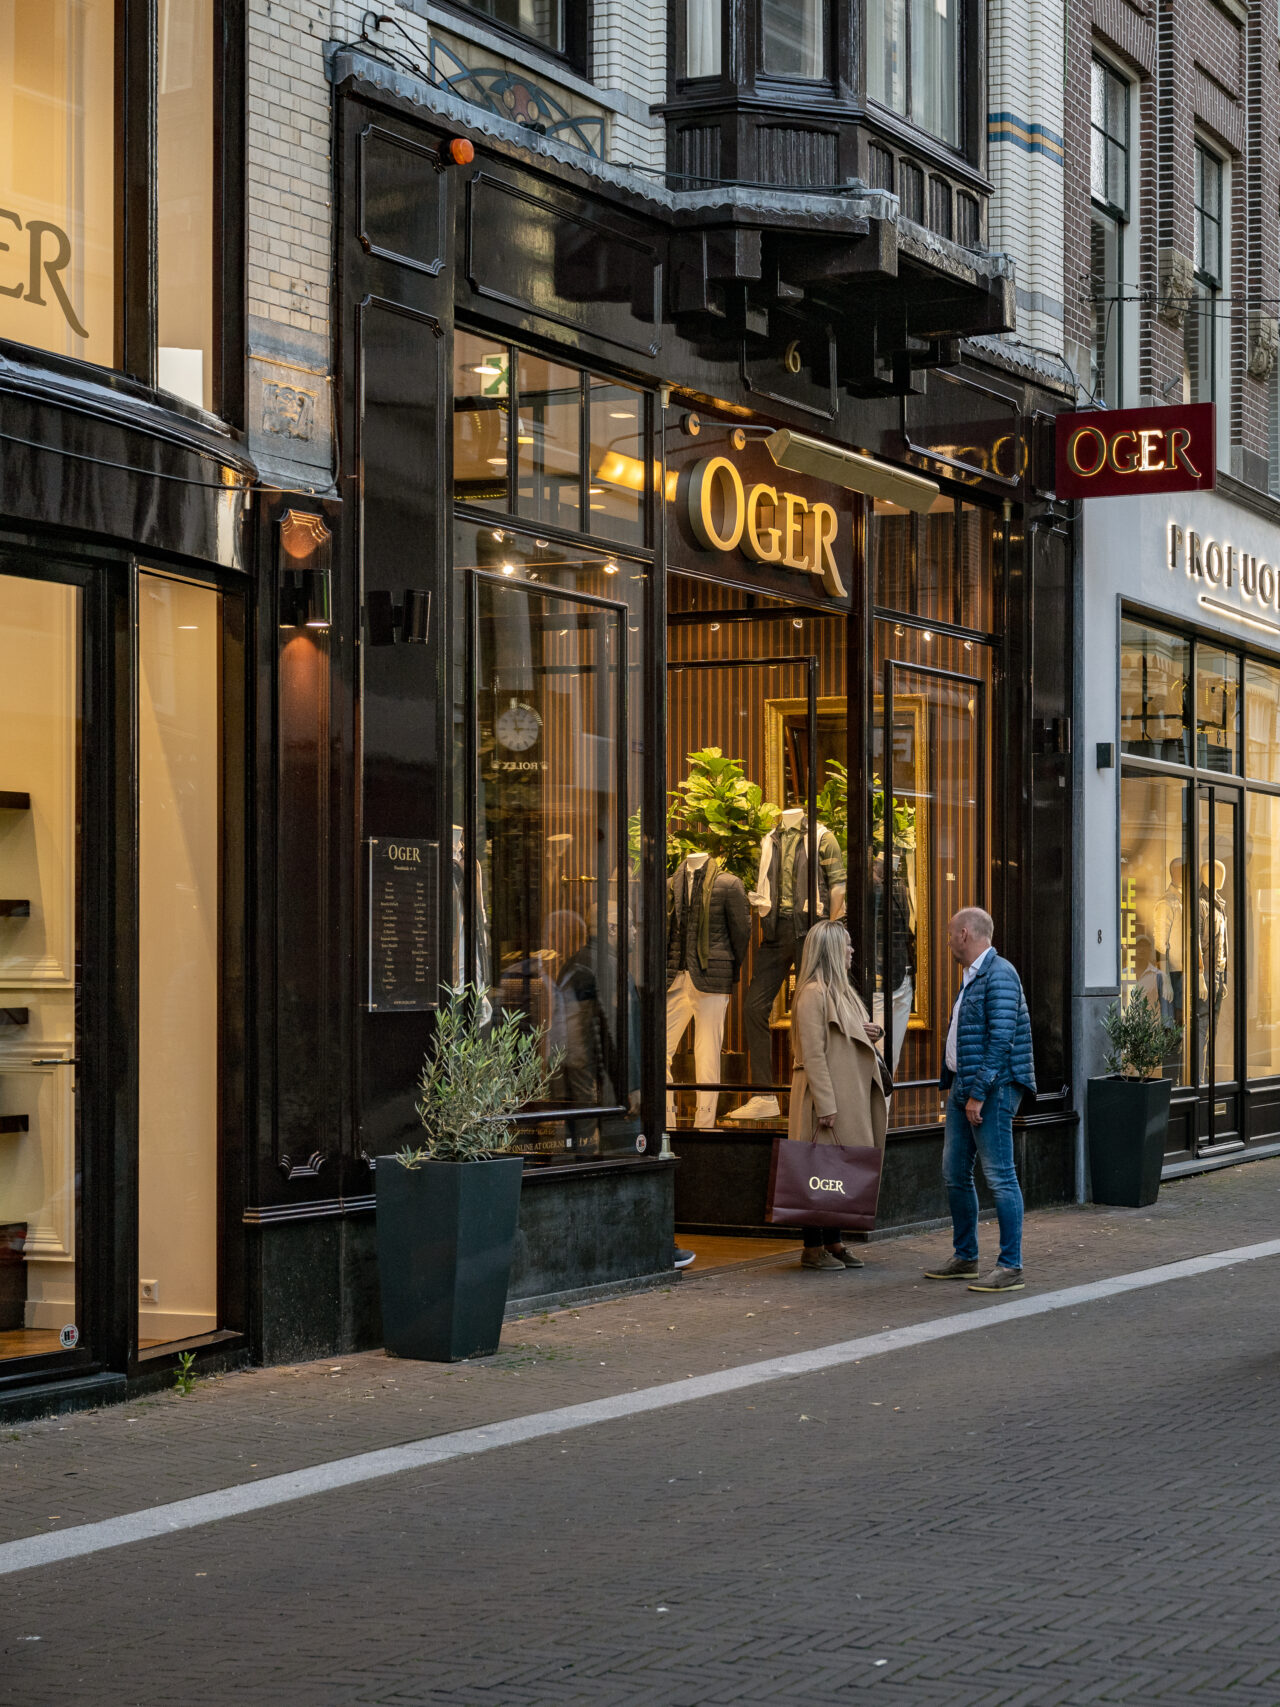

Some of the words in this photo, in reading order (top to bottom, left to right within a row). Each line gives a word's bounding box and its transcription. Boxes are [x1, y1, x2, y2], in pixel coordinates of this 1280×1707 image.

[1067, 427, 1202, 477] OGER
[690, 456, 848, 598] OGER
[388, 844, 421, 863] OGER
[809, 1176, 846, 1195] OGER
